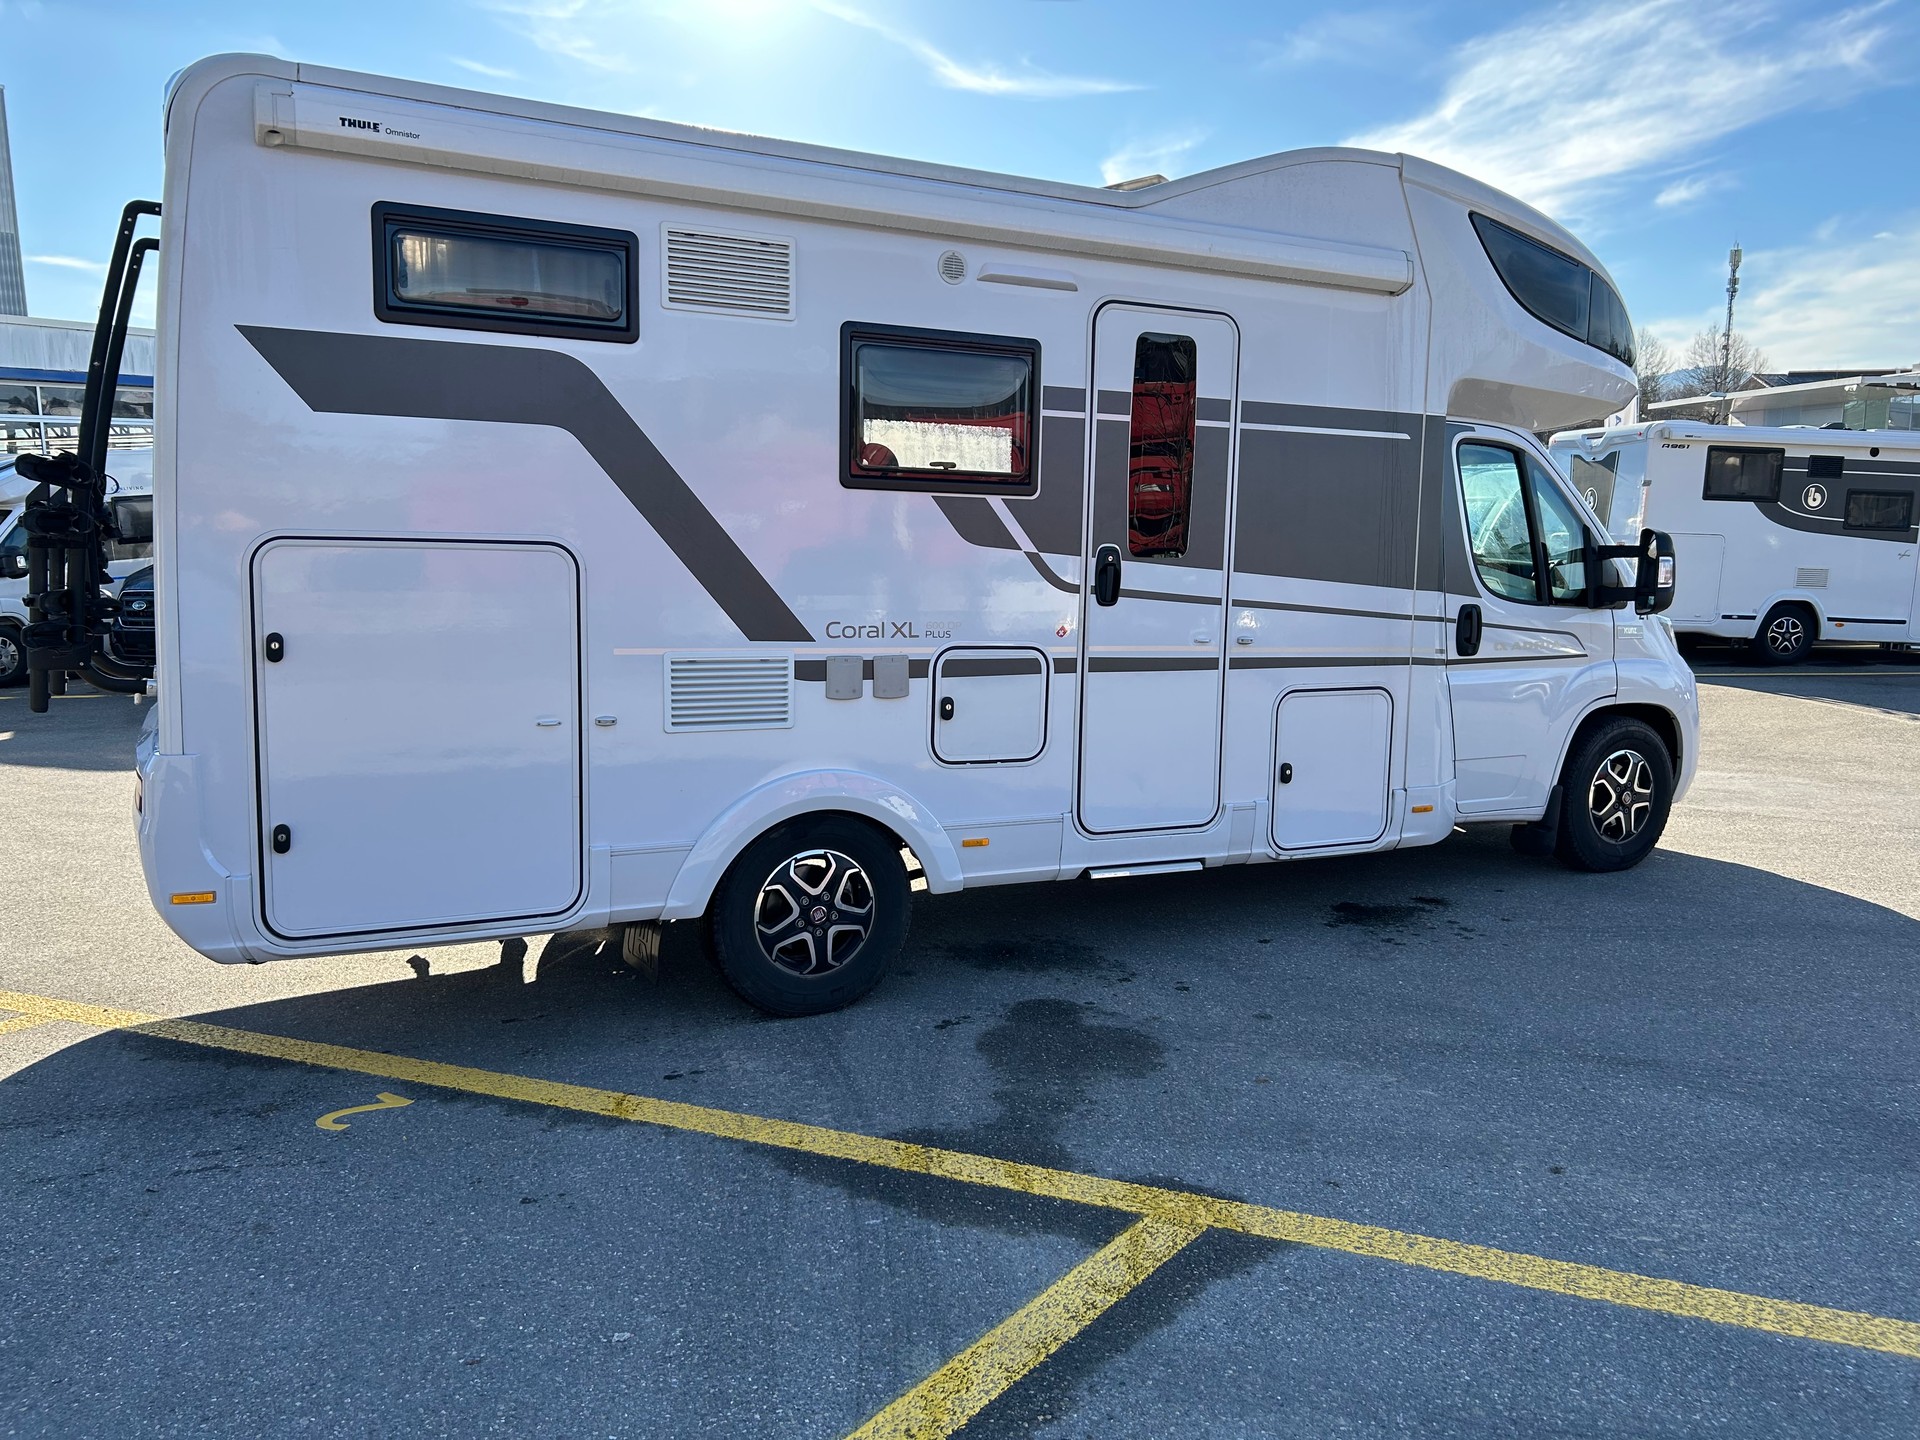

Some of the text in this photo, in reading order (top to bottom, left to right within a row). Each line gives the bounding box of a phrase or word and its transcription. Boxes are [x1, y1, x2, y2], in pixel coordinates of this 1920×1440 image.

[339, 117, 420, 139] THULE Omnistor
[826, 621, 920, 638] Coral XL
[925, 630, 951, 638] PLUS
